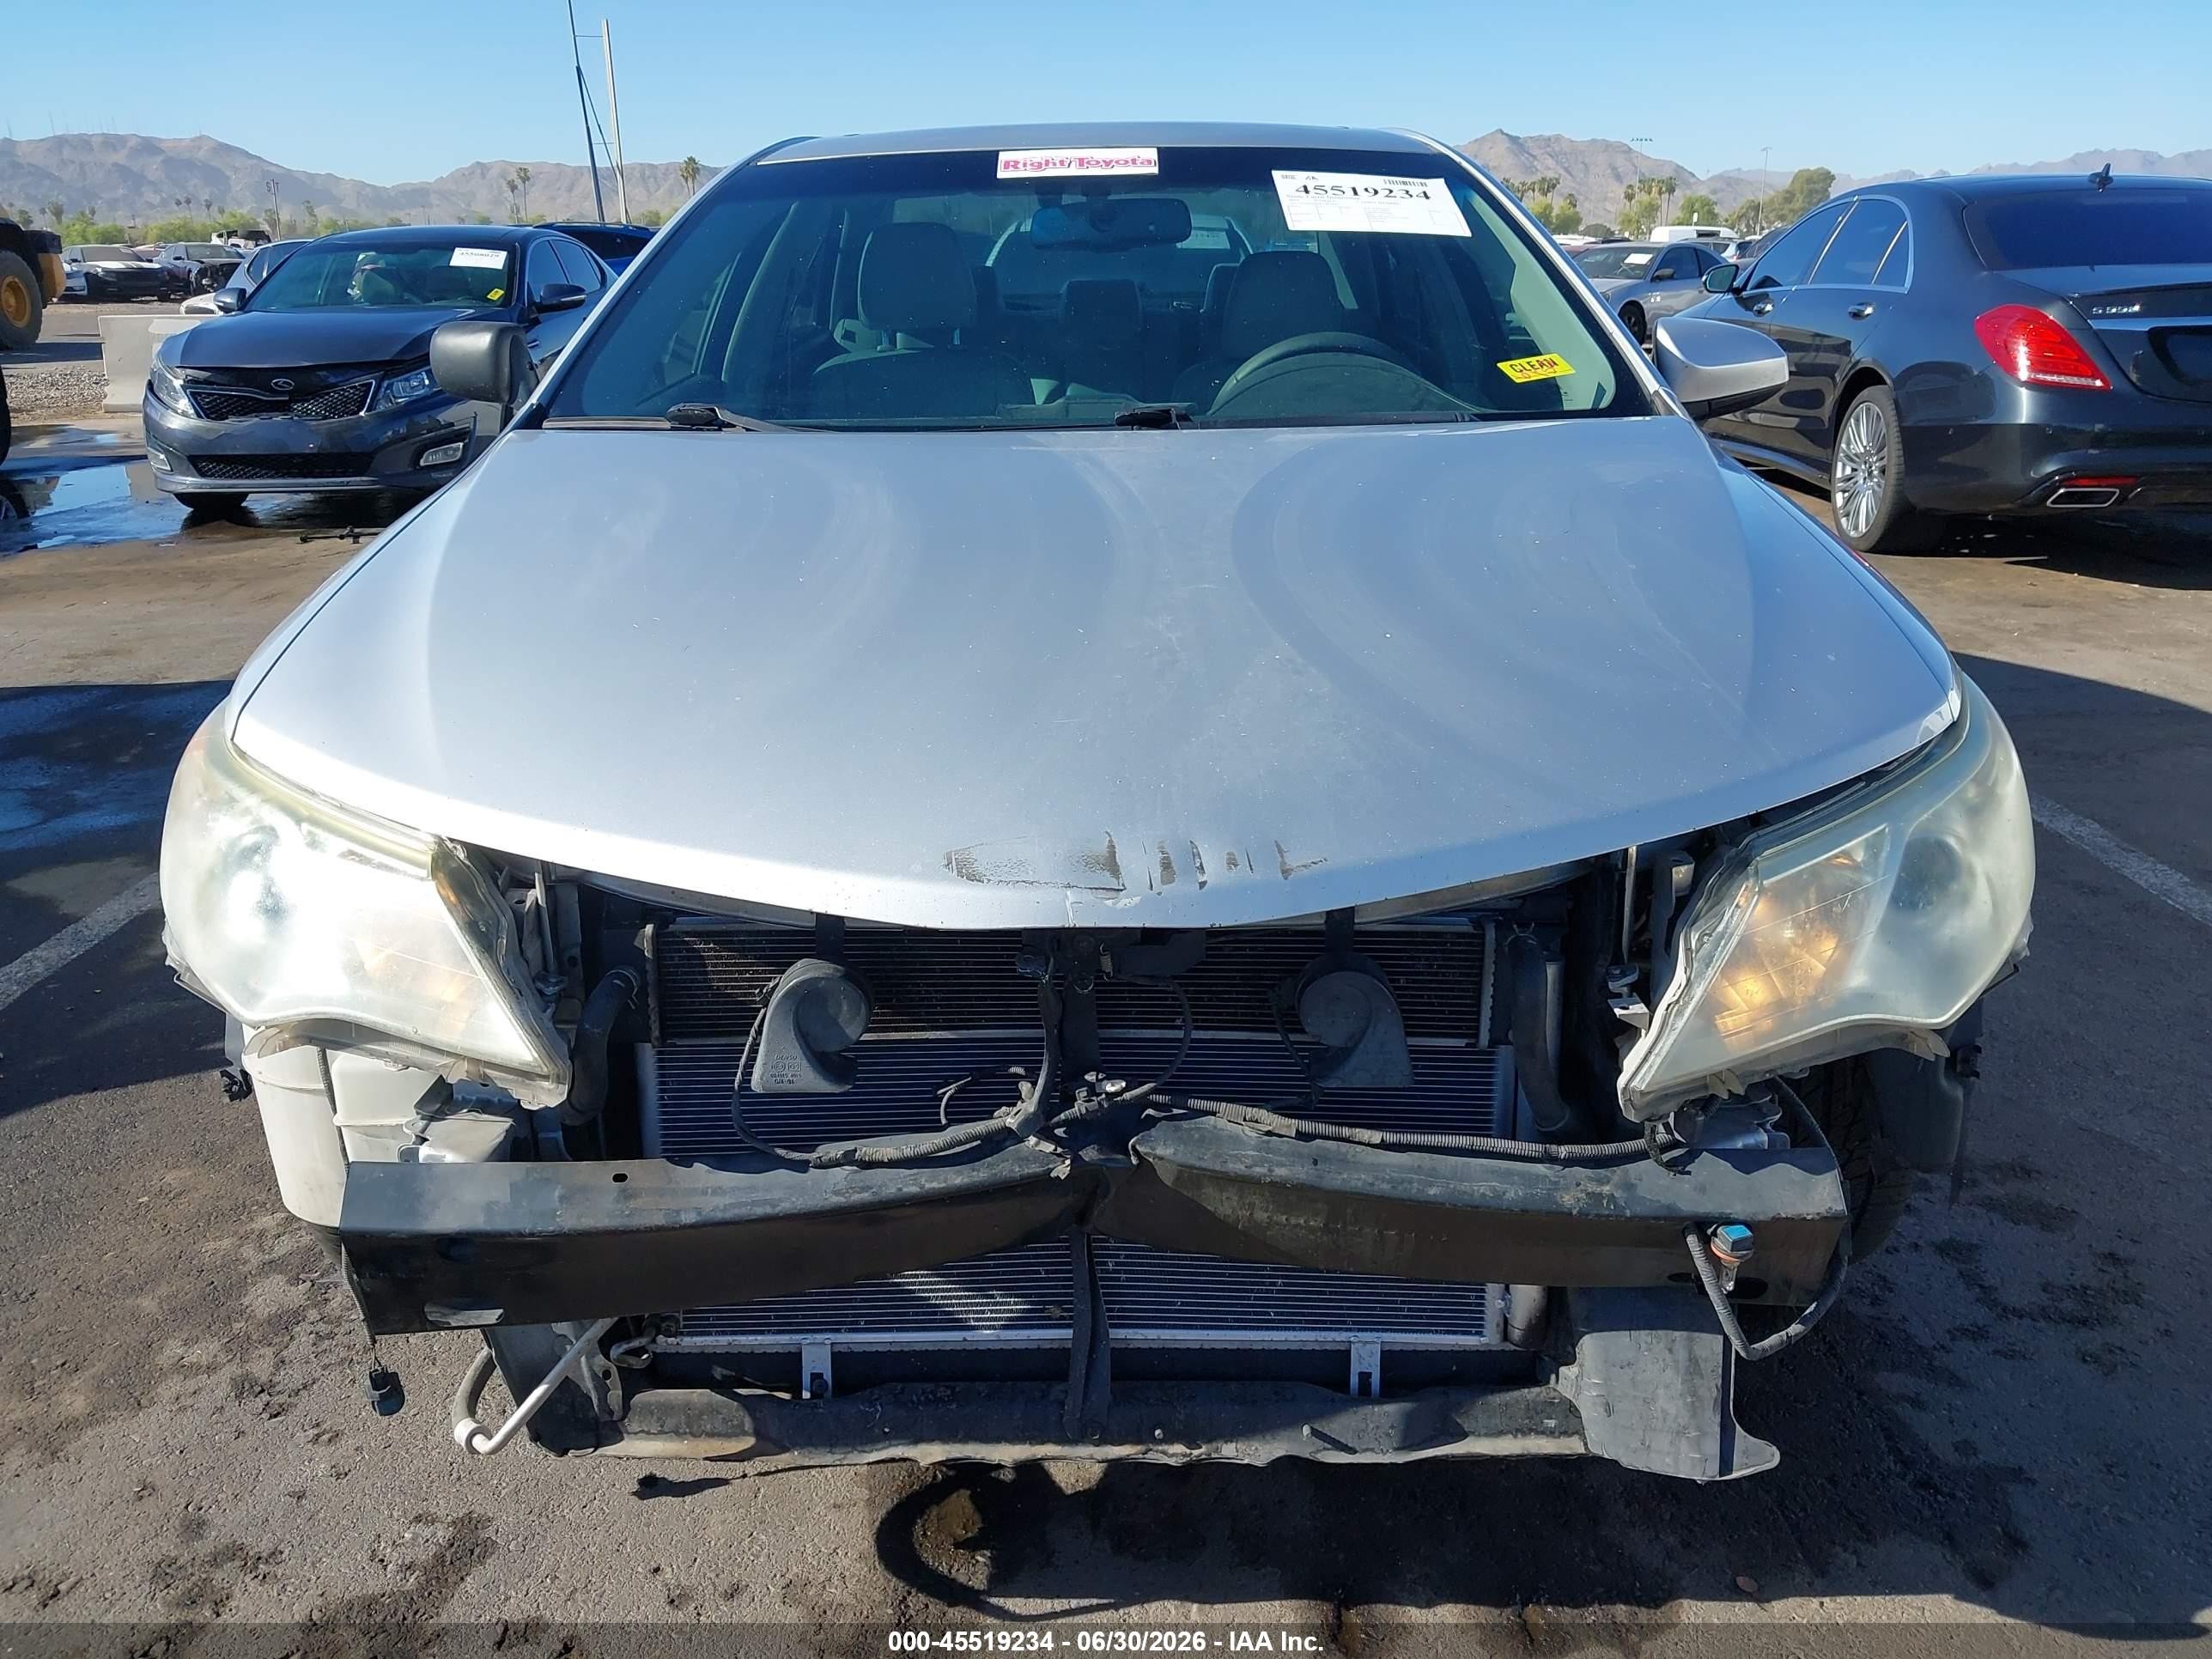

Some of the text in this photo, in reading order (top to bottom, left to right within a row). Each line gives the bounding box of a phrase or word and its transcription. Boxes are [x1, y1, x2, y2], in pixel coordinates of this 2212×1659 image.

[1001, 155, 1157, 172] Right Toyota
[1295, 184, 1431, 200] 45519234
[1509, 357, 1559, 374] CLEAN
